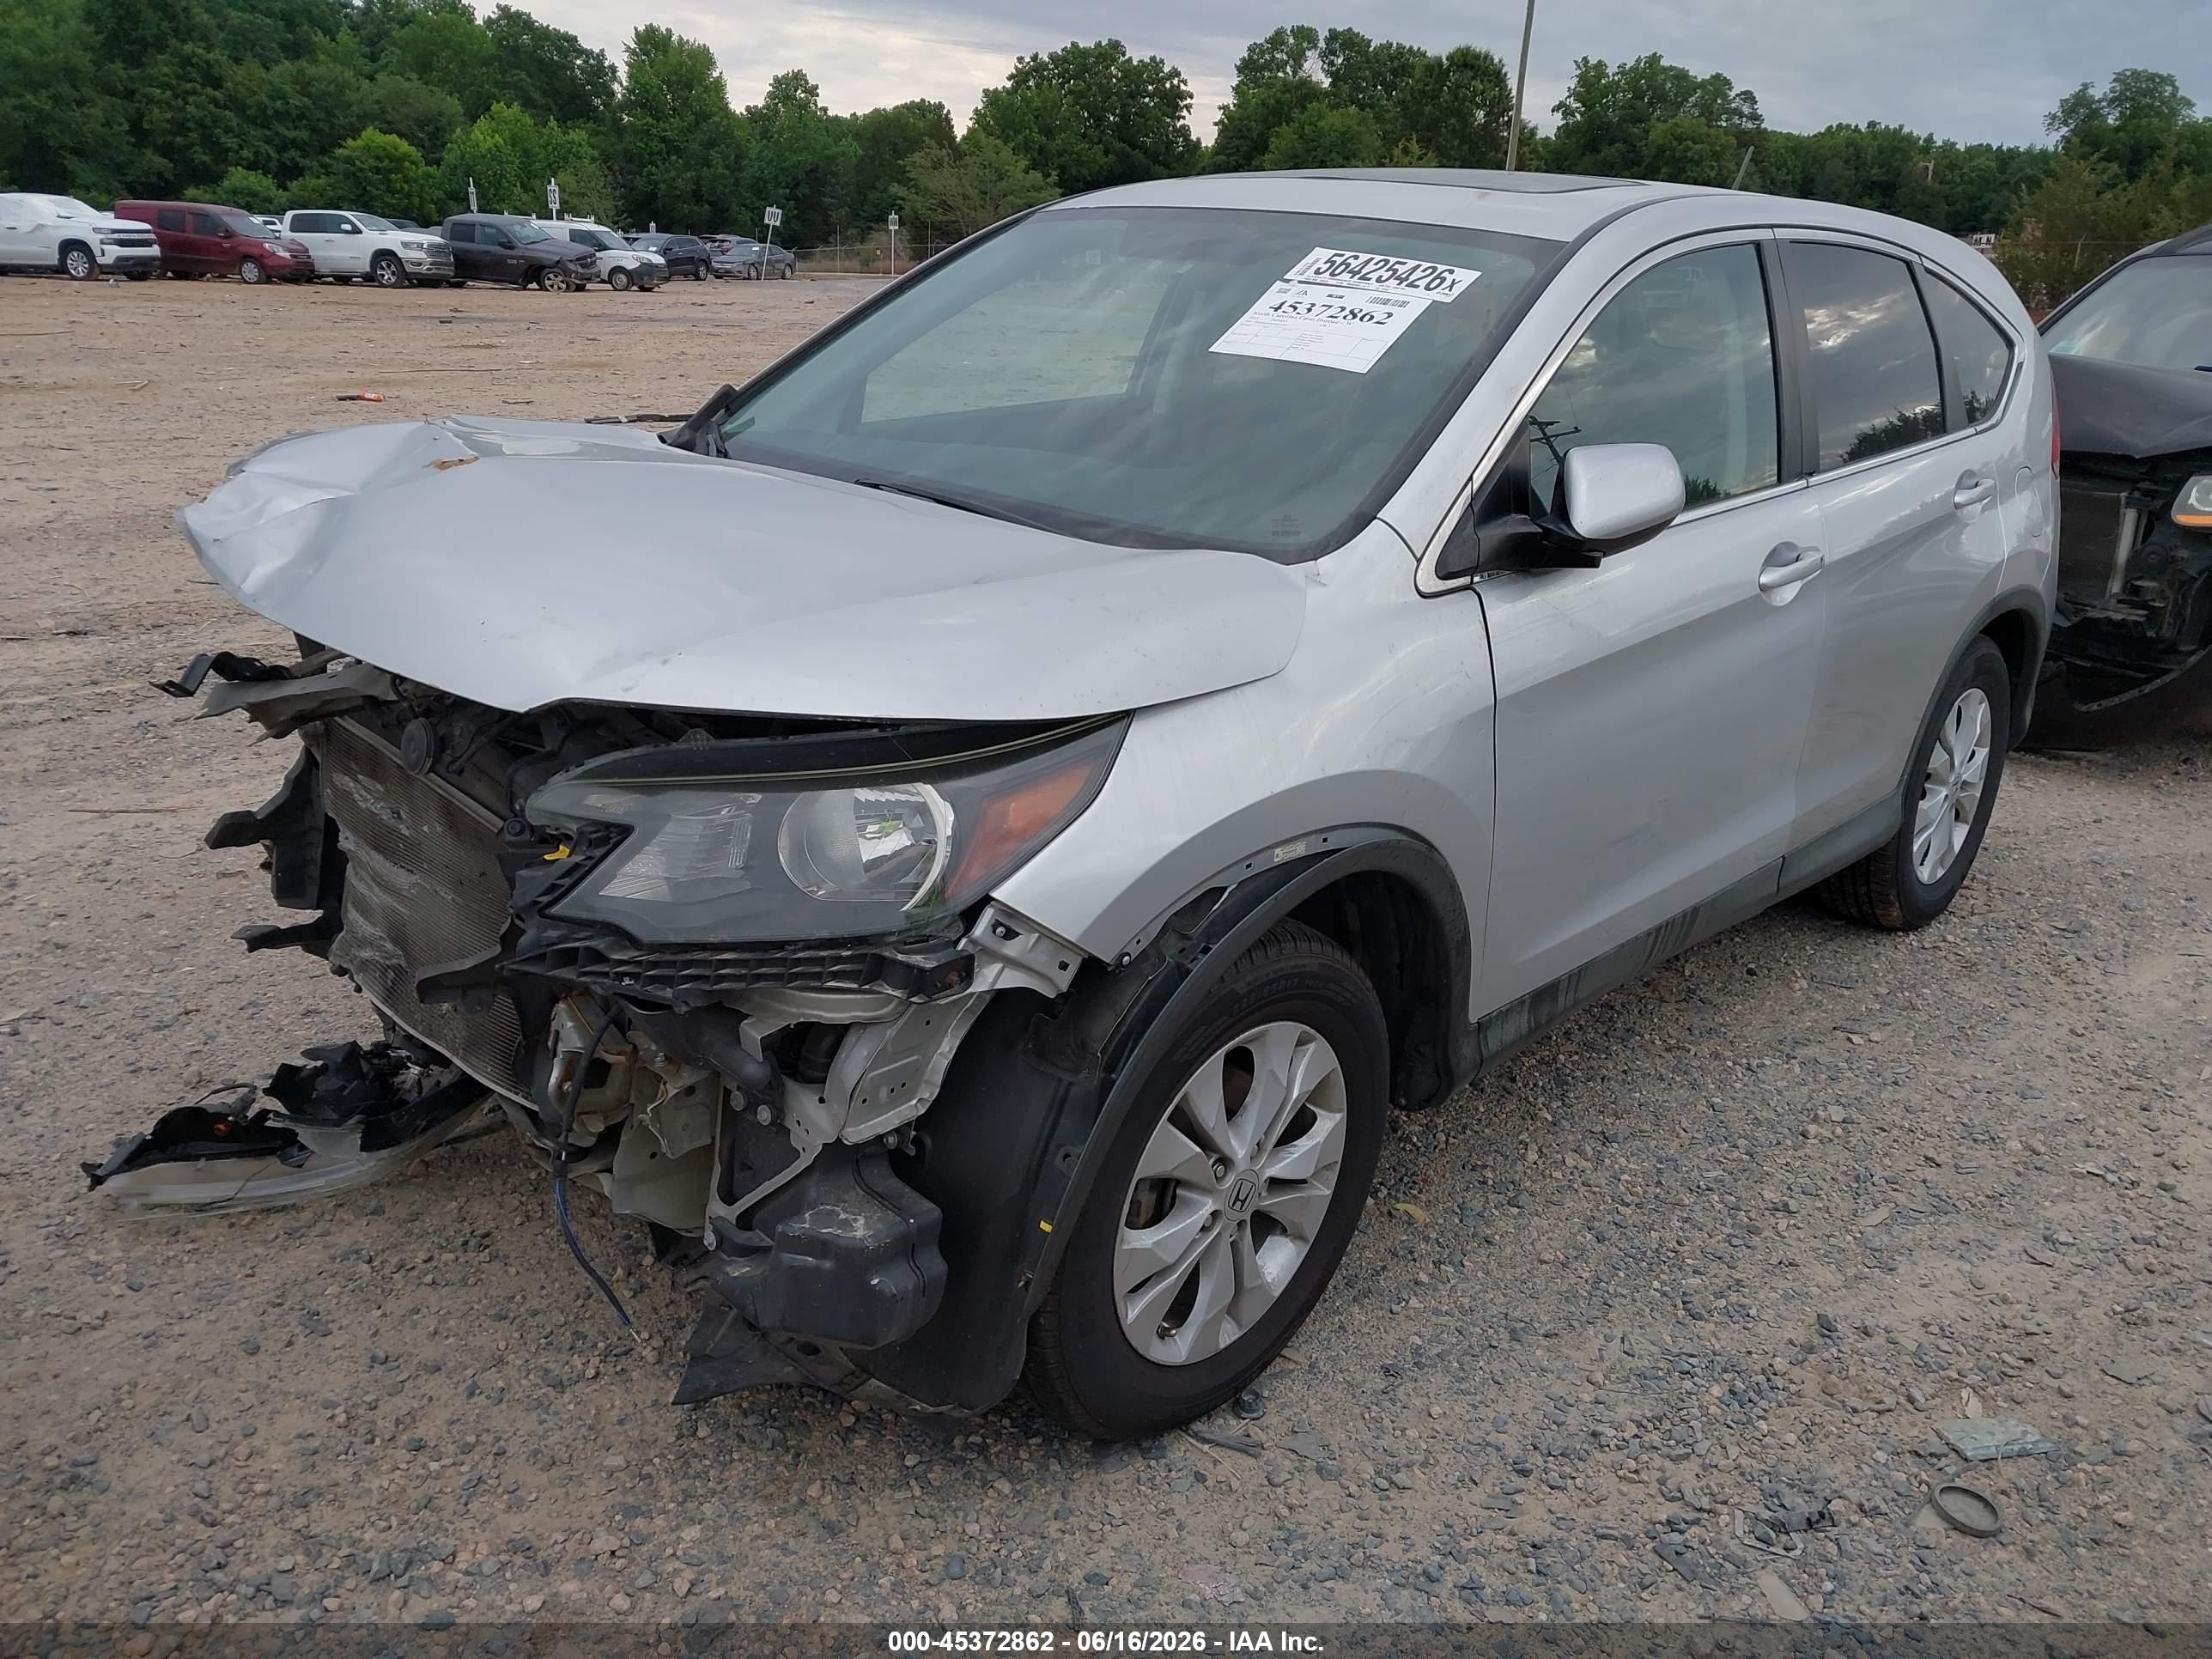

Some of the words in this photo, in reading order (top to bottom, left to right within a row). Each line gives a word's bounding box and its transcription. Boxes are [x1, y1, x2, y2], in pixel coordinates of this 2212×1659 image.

[549, 188, 557, 205] SS
[768, 210, 779, 222] UU
[1268, 300, 1394, 325] 45372862
